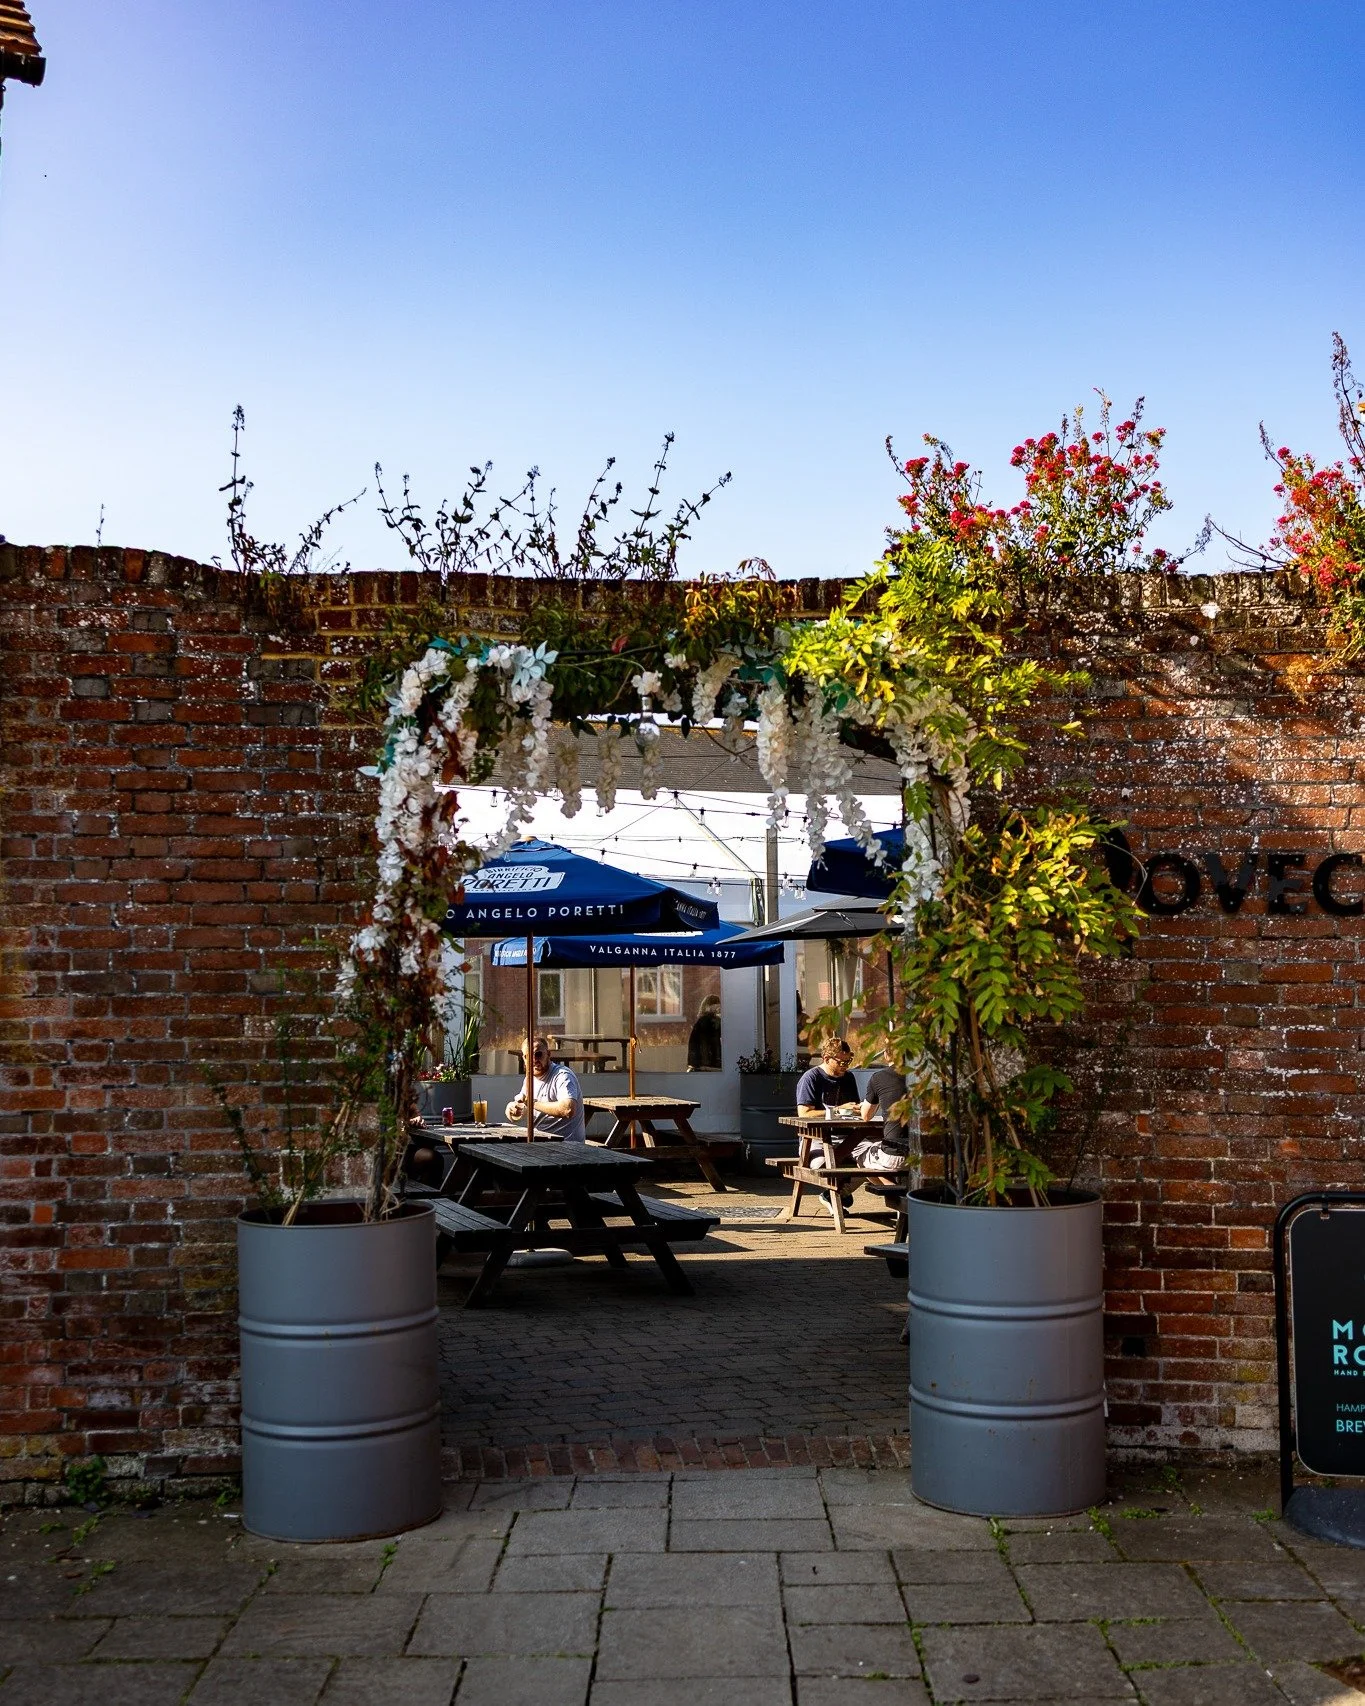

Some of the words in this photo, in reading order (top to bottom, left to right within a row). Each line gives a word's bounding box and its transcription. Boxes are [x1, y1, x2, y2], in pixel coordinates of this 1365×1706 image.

[487, 871, 534, 879] ANGELO
[462, 877, 552, 889] PORETTI
[466, 907, 538, 919] ANGELO
[548, 904, 624, 917] PORETTI
[589, 945, 657, 956] VALGANNA
[664, 948, 705, 958] ITALIA
[711, 951, 736, 959] 1877
[1332, 1319, 1365, 1340] M
[1333, 1369, 1359, 1377] HAND
[1336, 1419, 1365, 1433] BRE
